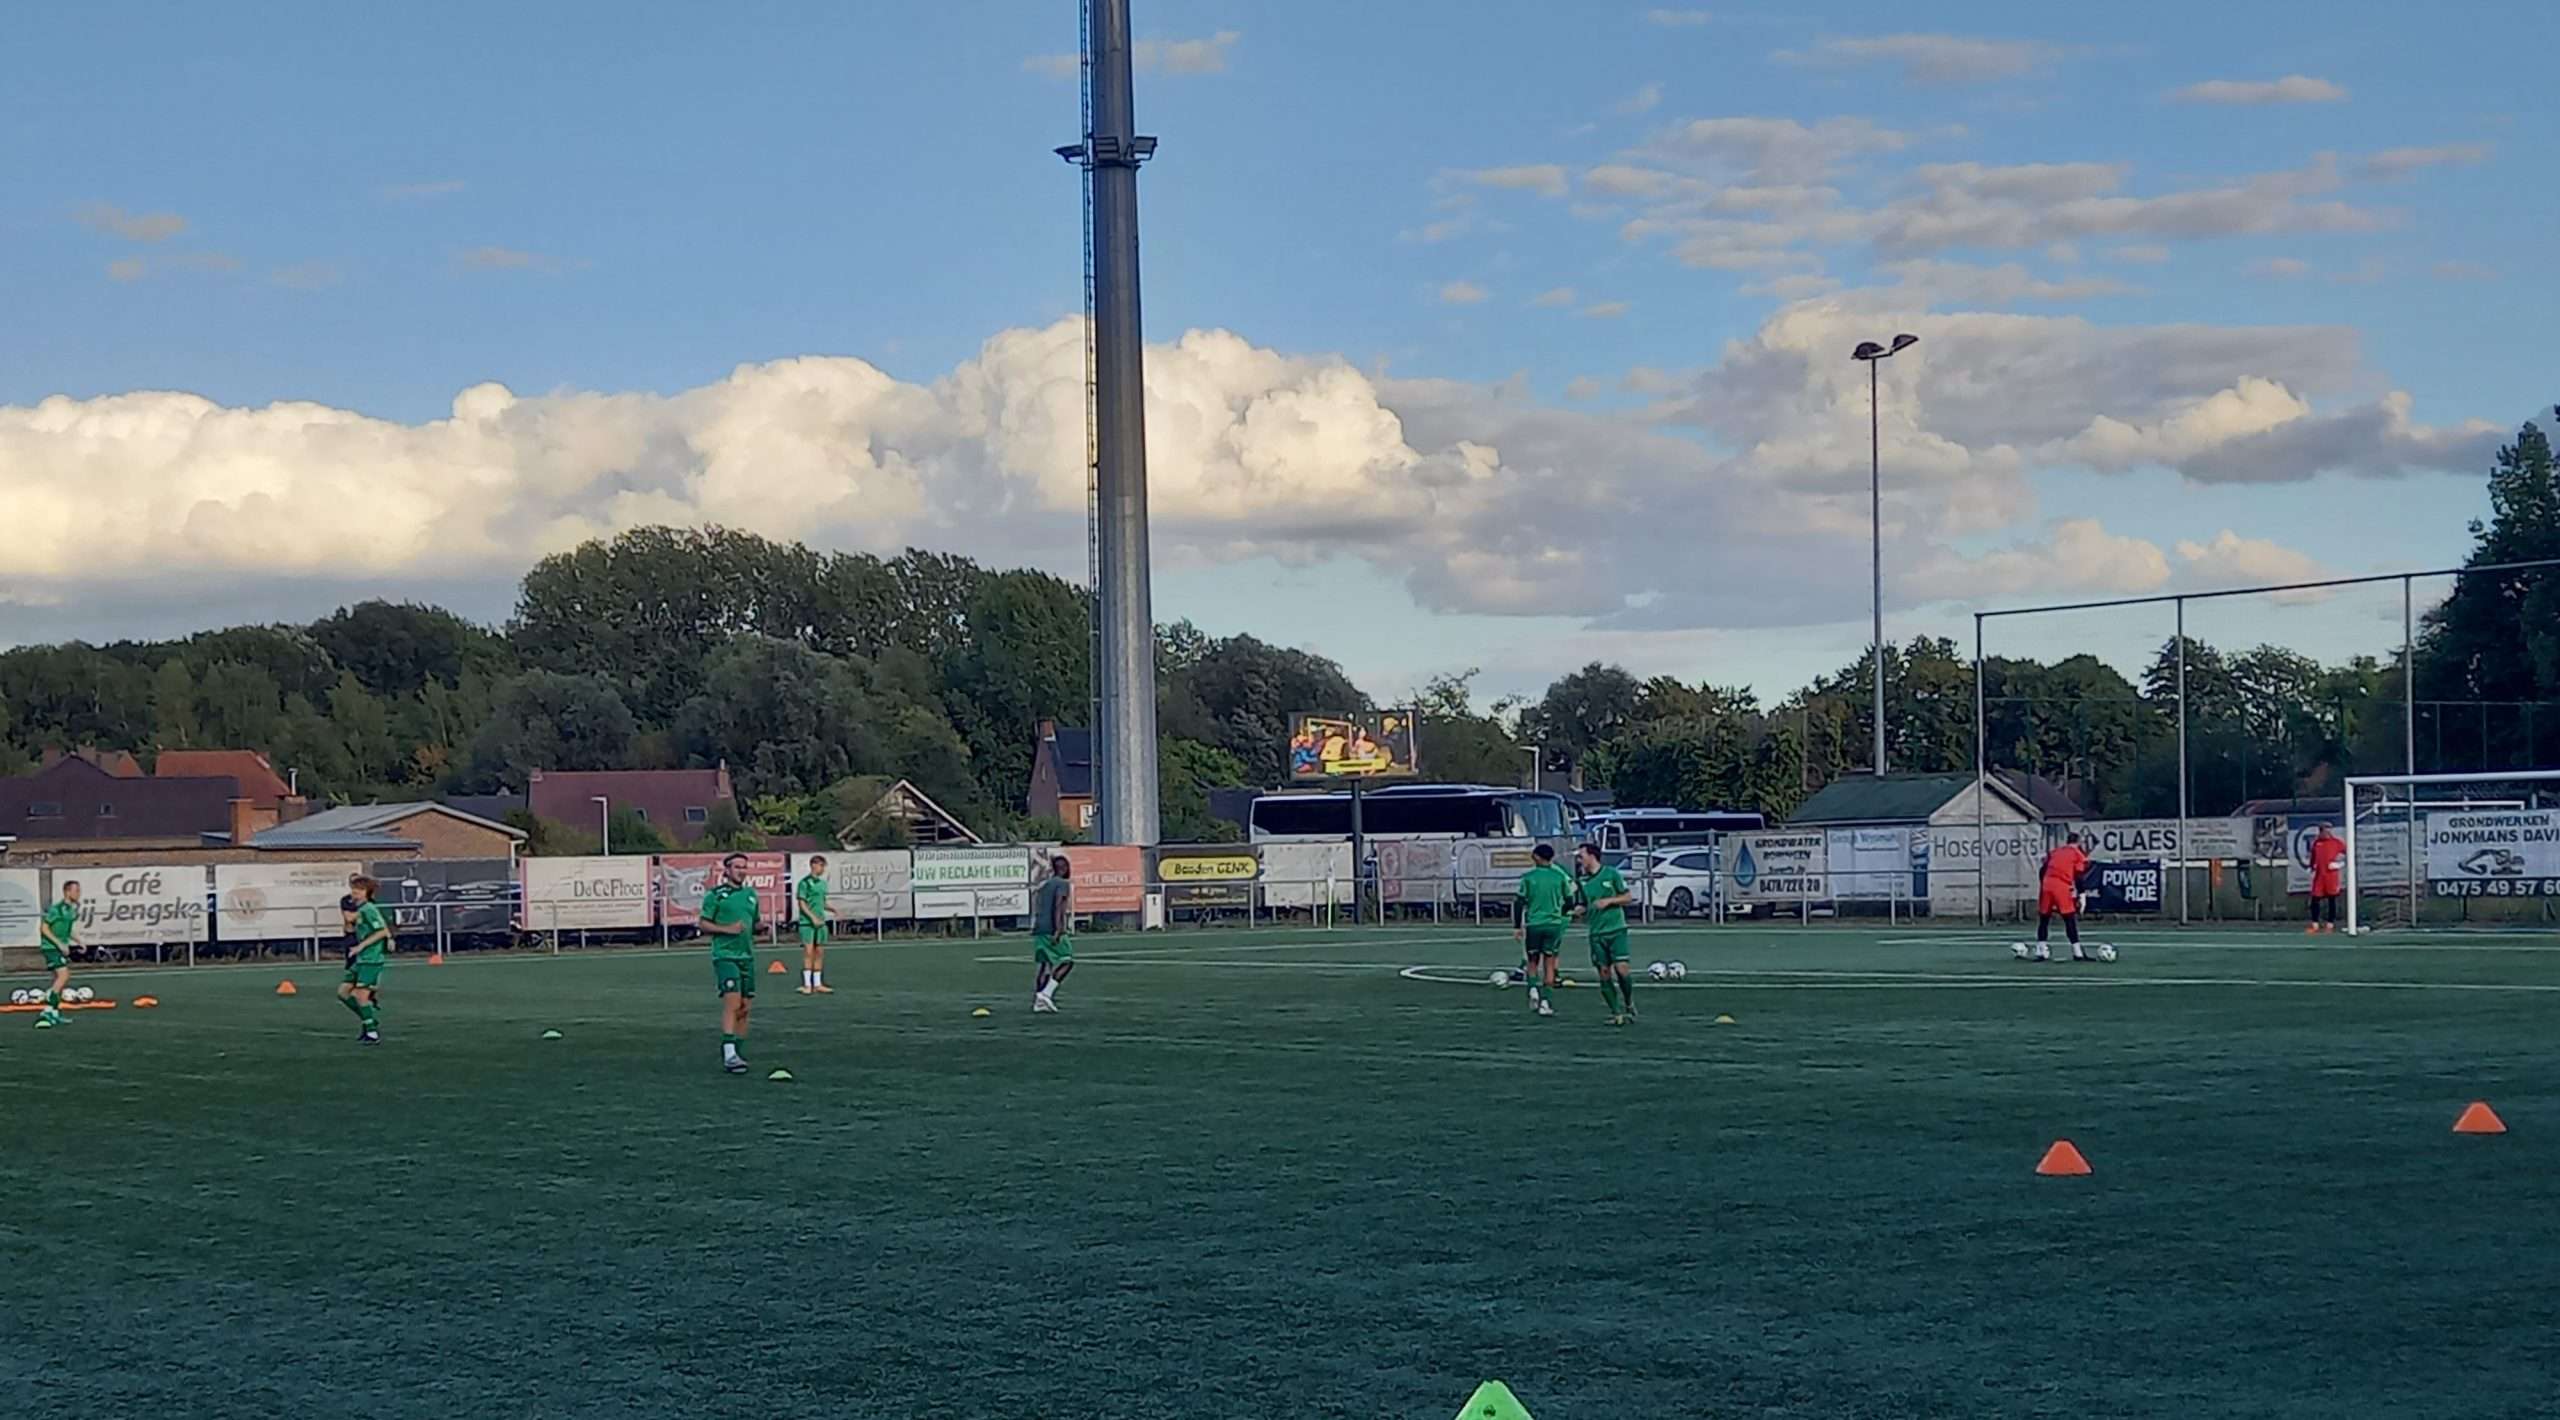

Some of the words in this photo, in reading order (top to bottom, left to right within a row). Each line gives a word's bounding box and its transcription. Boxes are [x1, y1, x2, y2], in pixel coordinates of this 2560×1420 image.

[2449, 815, 2550, 828] GRONDWERKEN
[2104, 830, 2177, 851] CLAES
[2430, 829, 2518, 844] JONKMANS
[915, 867, 937, 880] UW
[940, 865, 992, 880] RECLAME
[994, 864, 1026, 878] HIER?
[2102, 870, 2157, 886] POWER
[105, 872, 162, 896] Café
[2437, 881, 2482, 896] 0475
[2486, 881, 2511, 895] 49
[2515, 880, 2539, 895] 57
[2125, 886, 2158, 902] ADE
[102, 896, 201, 927] Jengske
